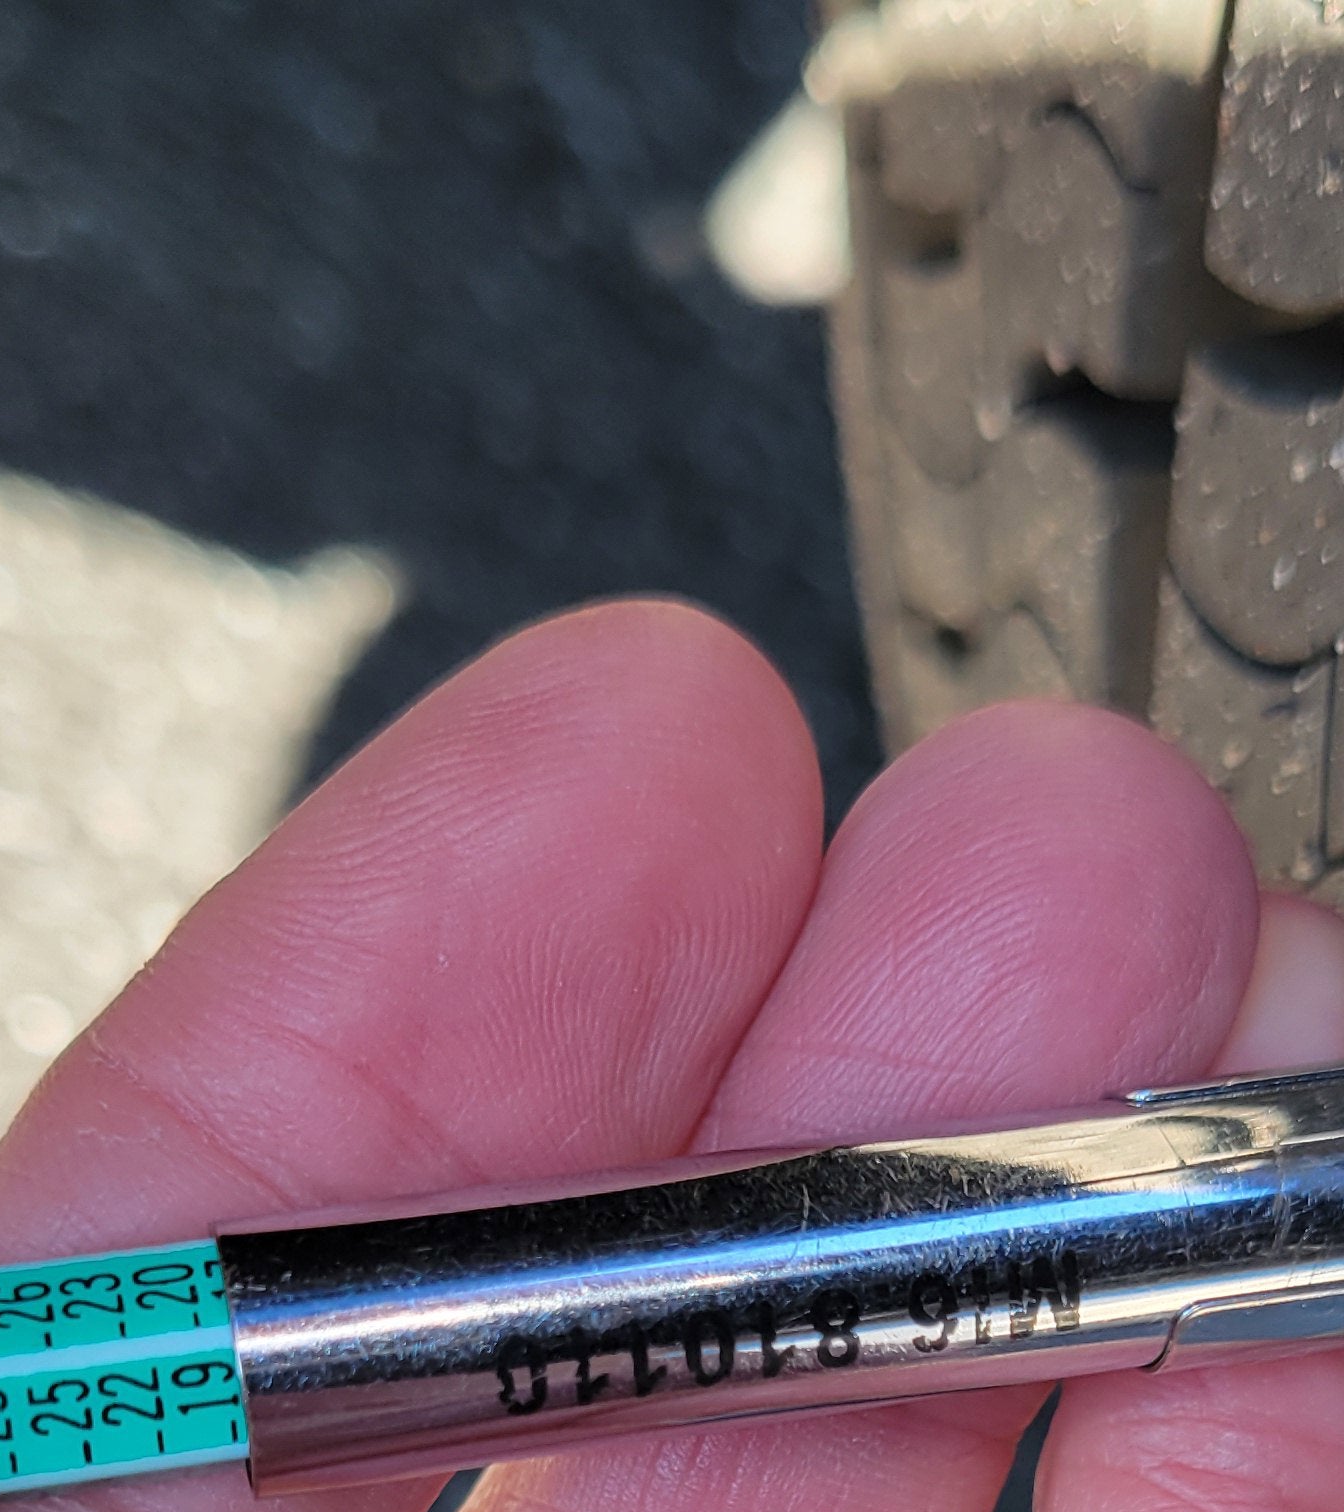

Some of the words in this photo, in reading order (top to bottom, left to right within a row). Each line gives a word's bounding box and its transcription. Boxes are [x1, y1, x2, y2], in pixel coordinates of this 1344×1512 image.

[60, 1274, 122, 1319] 23
[133, 1263, 198, 1309] 20
[27, 1379, 93, 1435] 25
[98, 1368, 163, 1425] 22
[172, 1362, 239, 1414] 19
